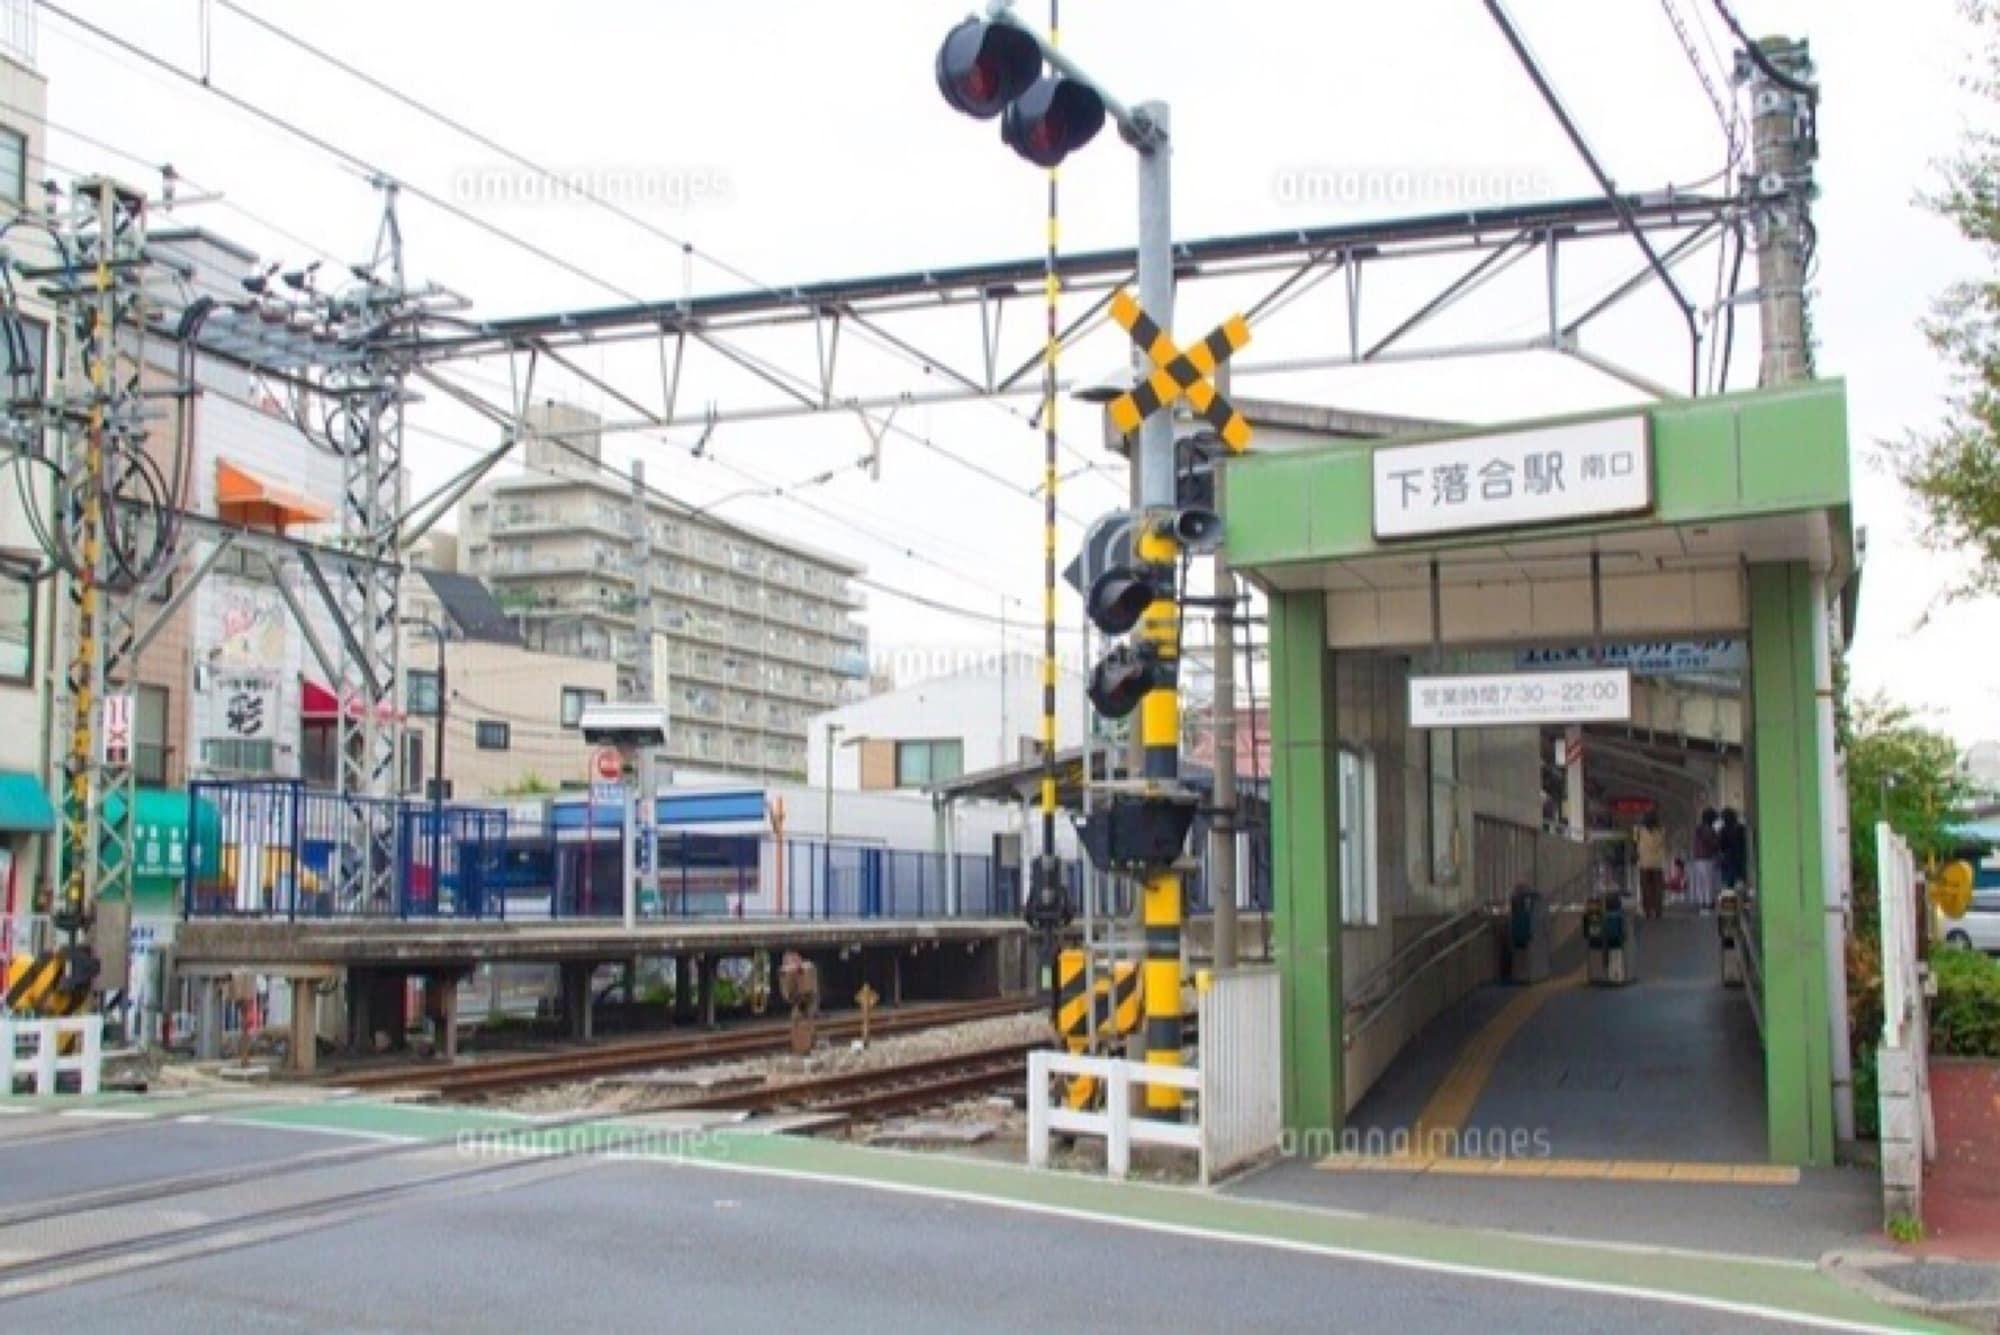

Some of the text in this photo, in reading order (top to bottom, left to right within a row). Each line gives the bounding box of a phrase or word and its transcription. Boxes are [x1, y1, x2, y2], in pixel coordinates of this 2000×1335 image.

[1387, 451, 1633, 510] 下落合駅 南口
